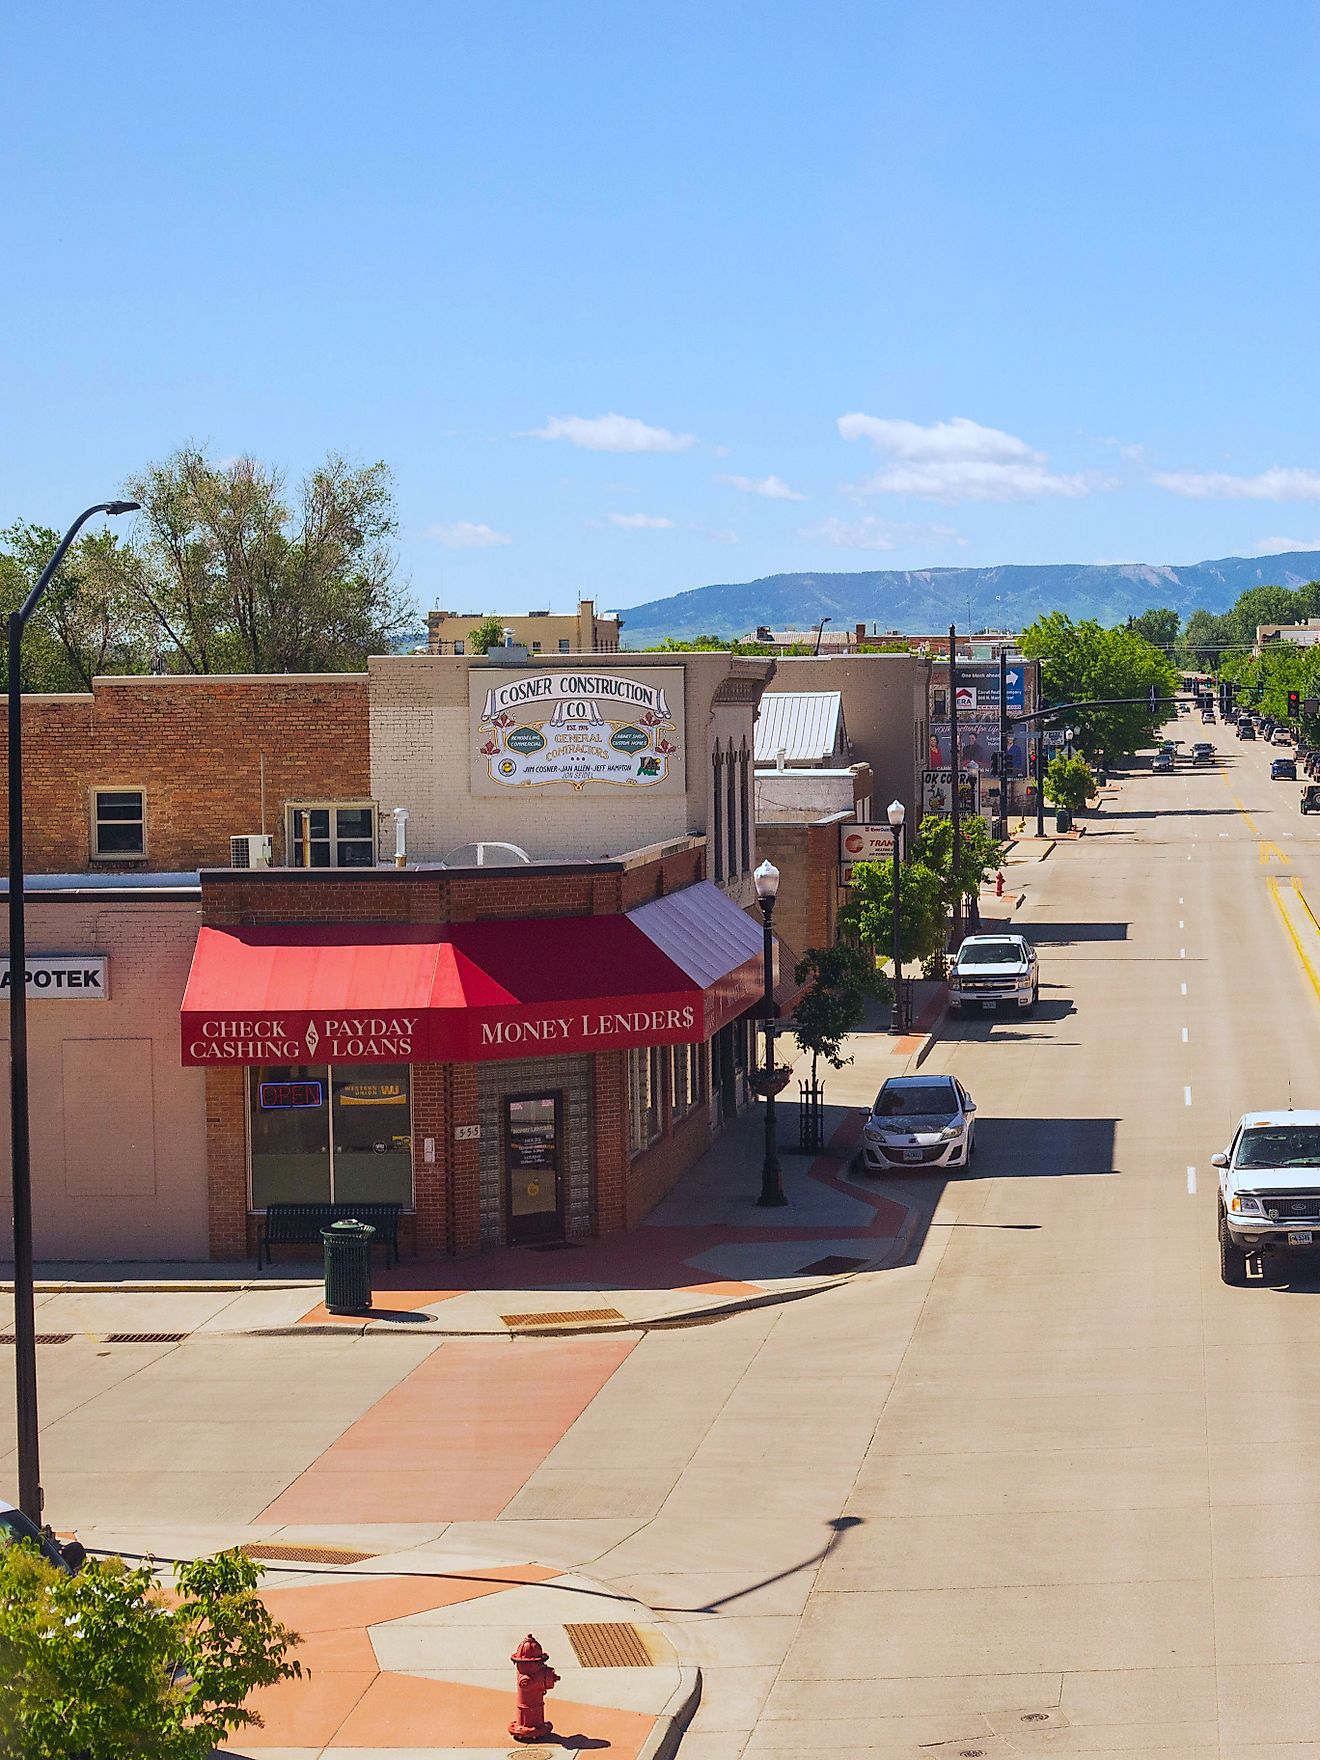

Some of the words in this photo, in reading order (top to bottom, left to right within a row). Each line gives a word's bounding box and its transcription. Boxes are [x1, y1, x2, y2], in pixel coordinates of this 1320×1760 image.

[500, 678, 553, 704] COSNER
[560, 677, 653, 705] CONSTRUCTION
[567, 702, 588, 718] CO.
[555, 734, 602, 743] GENERAL
[546, 744, 609, 761] CONTRACTORS
[925, 774, 939, 784] OK
[202, 1020, 287, 1038] CHECK
[325, 1018, 418, 1037] PAYDAY
[480, 1018, 574, 1045] MONEY
[581, 1005, 694, 1037] LENDER$
[190, 1041, 299, 1058] CASHING
[332, 1038, 412, 1056] LOANS
[263, 1085, 319, 1104] OPEN
[381, 1085, 400, 1095] WU
